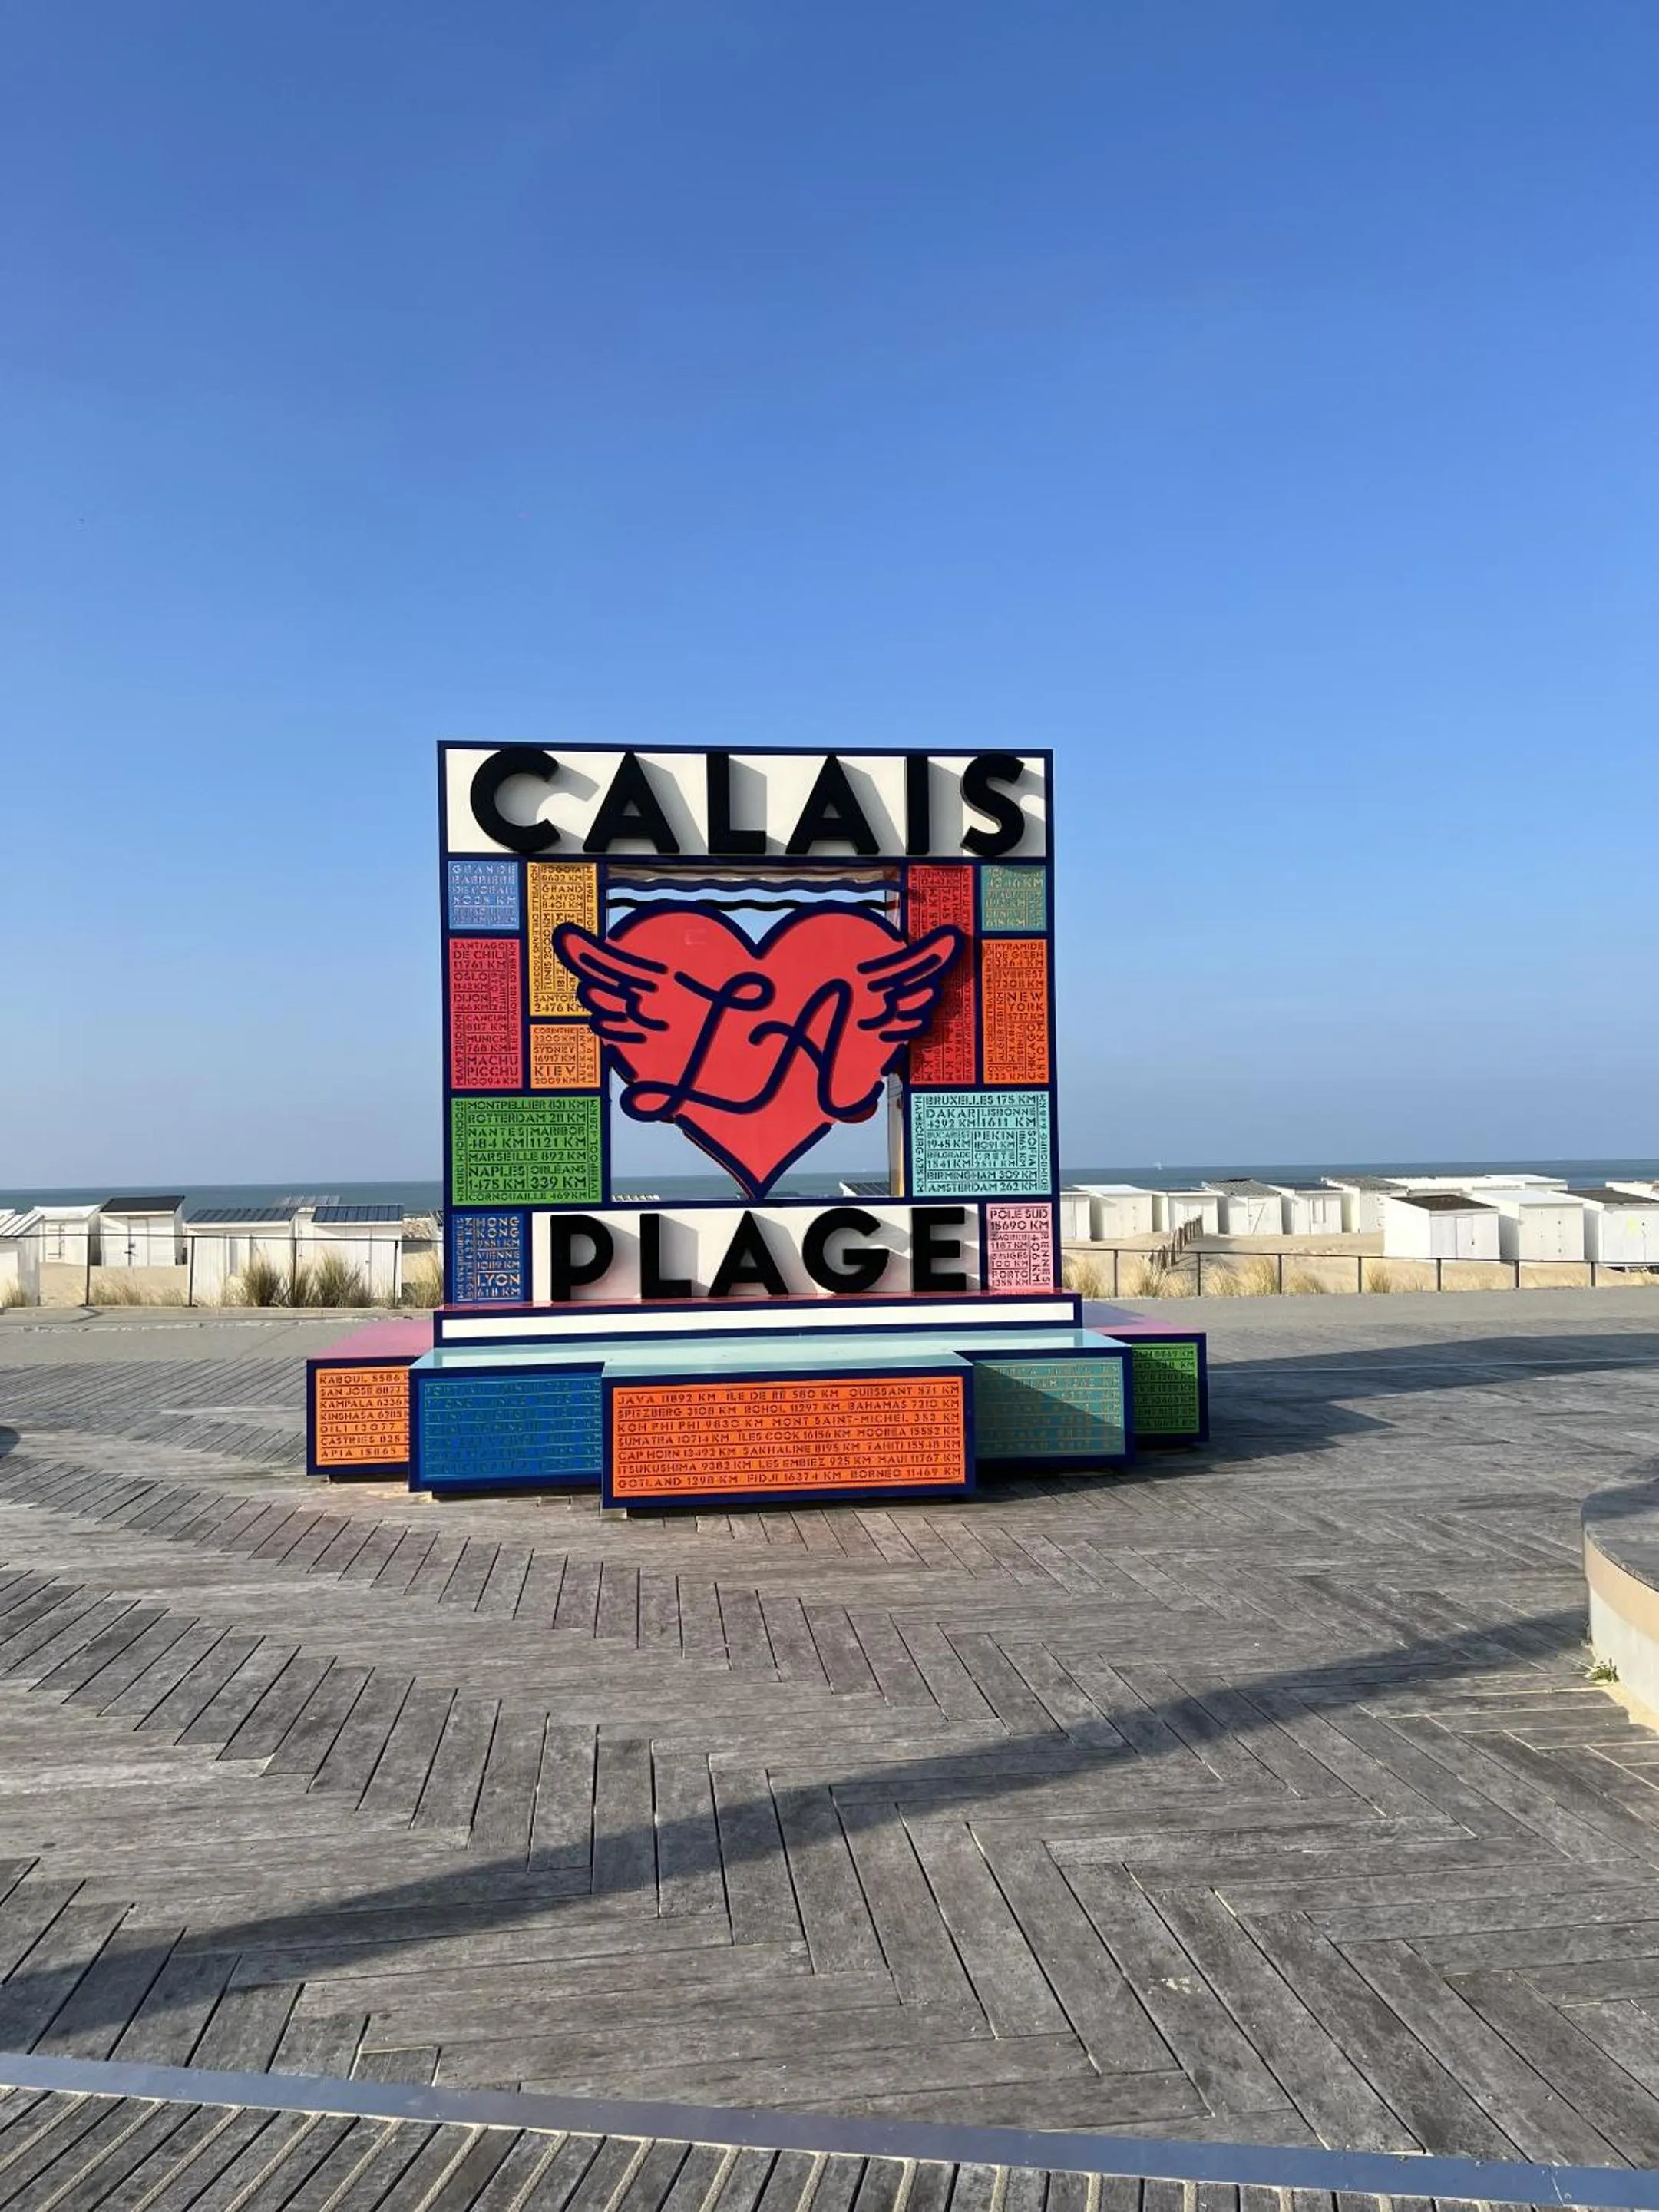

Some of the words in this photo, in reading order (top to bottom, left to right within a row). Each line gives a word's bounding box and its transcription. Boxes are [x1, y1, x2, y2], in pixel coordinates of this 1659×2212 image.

[469, 747, 1026, 855] CALAIS
[544, 961, 553, 990] TUNIS
[1007, 993, 1043, 1001] NEW
[620, 970, 887, 1123] LA
[468, 1056, 518, 1065] MACHU
[468, 1067, 518, 1076] PICCHU
[534, 1066, 575, 1076] KIEV
[468, 1100, 546, 1109] MONTPELLIER
[568, 1100, 586, 1109] KM
[926, 1096, 993, 1105] BRUXELLES
[998, 1096, 1013, 1104] 175
[590, 1100, 597, 1115] KM
[981, 1108, 1035, 1116] LISBONNE
[468, 1114, 545, 1123] ROTTERDAM
[567, 1113, 586, 1122] KM
[927, 1109, 975, 1118] DAKAR
[981, 1118, 1008, 1127] 1611
[1016, 1117, 1036, 1126] KM
[468, 1128, 525, 1136] NANTES
[530, 1126, 585, 1135] MARIBOR
[975, 1132, 1014, 1140] PEKIN
[503, 1138, 524, 1148] KM
[530, 1138, 558, 1147] 1121
[564, 1137, 586, 1146] KM
[468, 1152, 537, 1162] MARSEILLE
[567, 1152, 586, 1160] KM
[468, 1166, 525, 1177] NAPLES
[468, 1179, 500, 1189] 1475
[504, 1179, 525, 1189] KM
[530, 1177, 557, 1189] 339
[563, 1177, 587, 1188] KM
[928, 1183, 997, 1192] AMSTERDAM
[1022, 1182, 1037, 1192] KM
[1025, 1209, 1048, 1218] SUD
[477, 1217, 519, 1226] HONG
[1030, 1221, 1049, 1229] KM
[477, 1228, 519, 1238] KONG
[550, 1207, 967, 1303] PLAGE
[1032, 1265, 1040, 1282] KM
[478, 1274, 520, 1286] LYON
[618, 1395, 654, 1404] JAVA
[849, 1387, 912, 1397] OUESSANT
[942, 1386, 959, 1394] KM
[618, 1408, 682, 1419] SPITZBERG
[719, 1406, 736, 1414] KM
[848, 1401, 906, 1410] BAHAMAS
[321, 1412, 373, 1420] KINSHASA
[618, 1423, 646, 1432] KOH
[772, 1418, 808, 1427] MONT
[815, 1414, 908, 1425] SAINT-MICHEL
[321, 1437, 375, 1445] CASTRIES
[618, 1436, 673, 1446] SUMATRA
[618, 1451, 643, 1460] CAP
[646, 1450, 679, 1458] HORN
[719, 1447, 736, 1456] KM
[743, 1445, 811, 1455] SAKHALINE
[843, 1443, 860, 1451] KM
[618, 1463, 696, 1474] ITSUKUSHIMA
[734, 1460, 751, 1469] KM
[854, 1456, 871, 1464] KM
[878, 1455, 907, 1463] MAUI
[944, 1453, 960, 1462] KM
[618, 1477, 681, 1488] GOTLAND
[719, 1475, 738, 1483] KM
[747, 1473, 778, 1482] FIDJI
[851, 1469, 901, 1478] BORNEO
